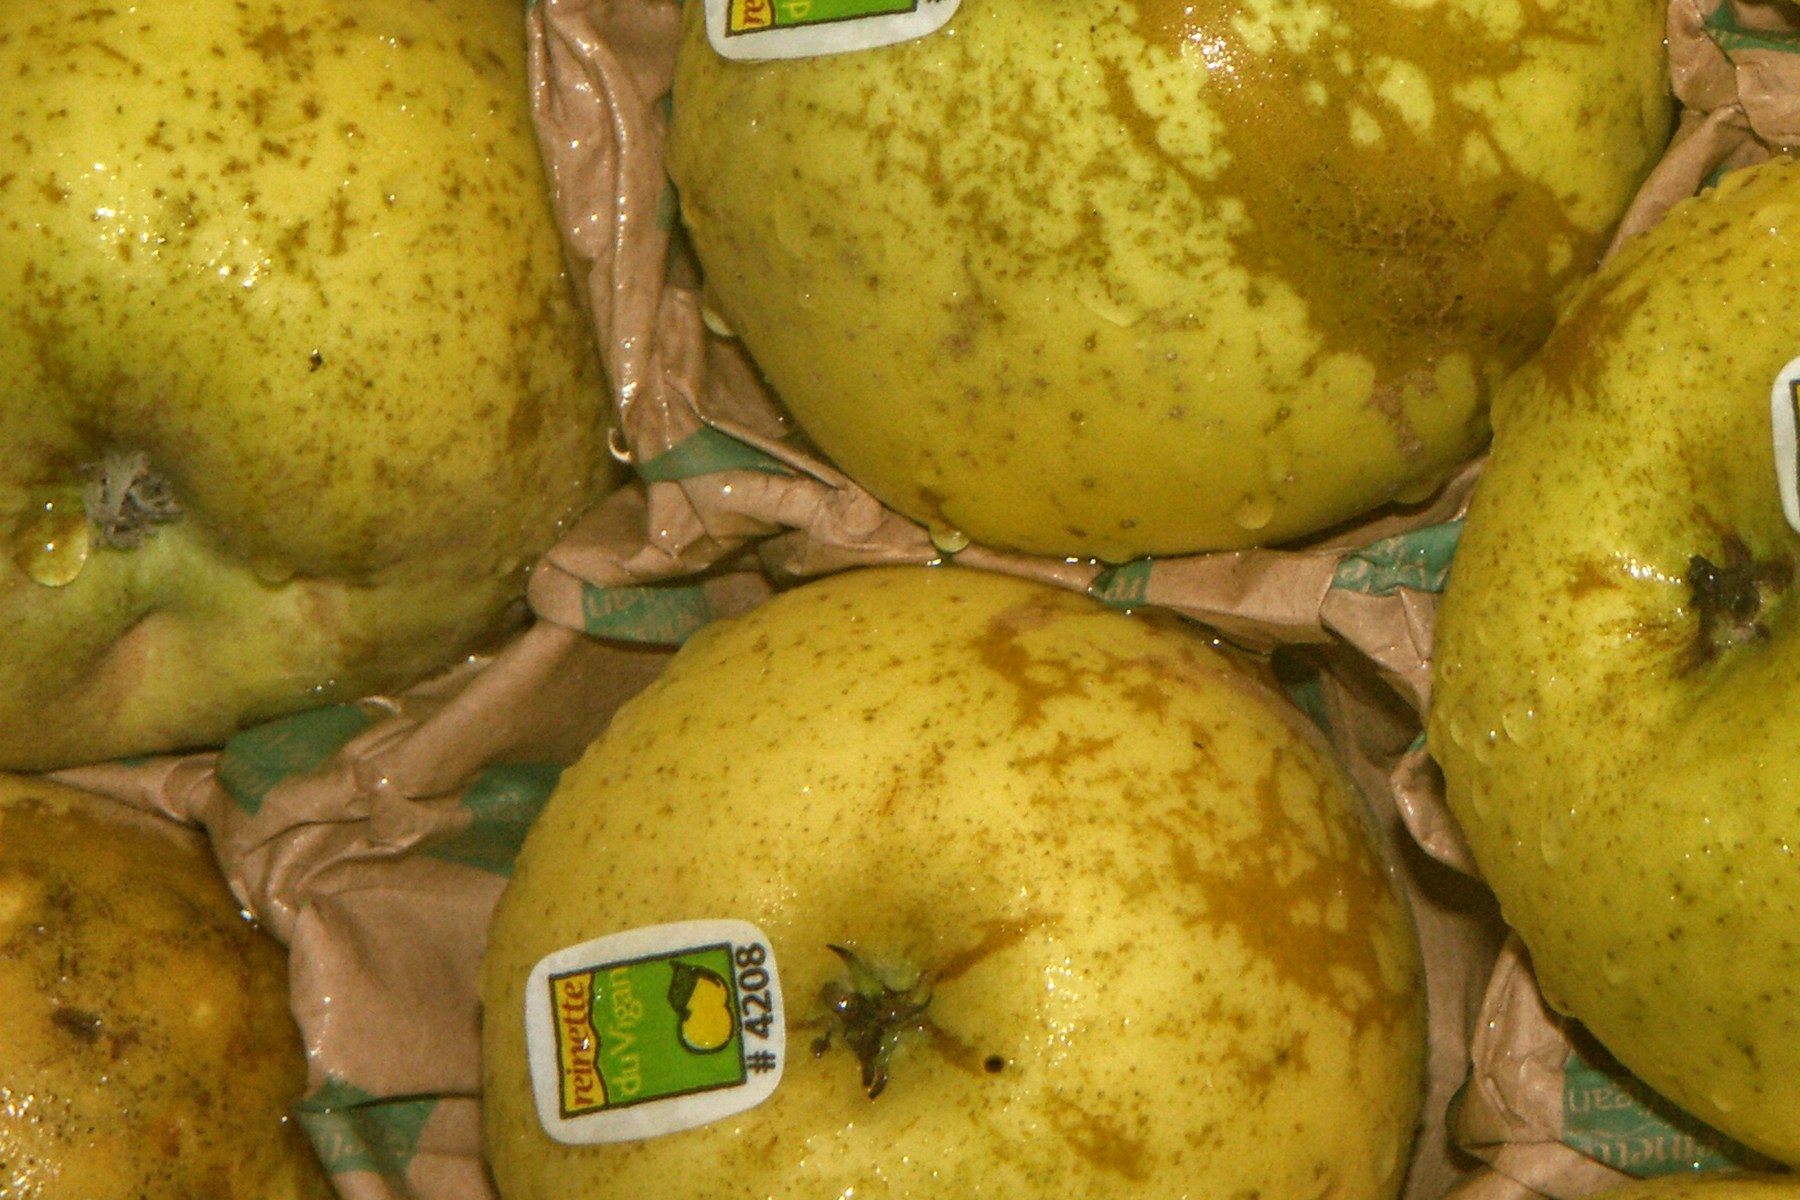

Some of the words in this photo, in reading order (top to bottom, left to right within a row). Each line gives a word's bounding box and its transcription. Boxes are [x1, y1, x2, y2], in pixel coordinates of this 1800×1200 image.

[735, 942, 774, 1040] 4208
[562, 980, 595, 1107] reinette
[746, 1049, 777, 1075] #
